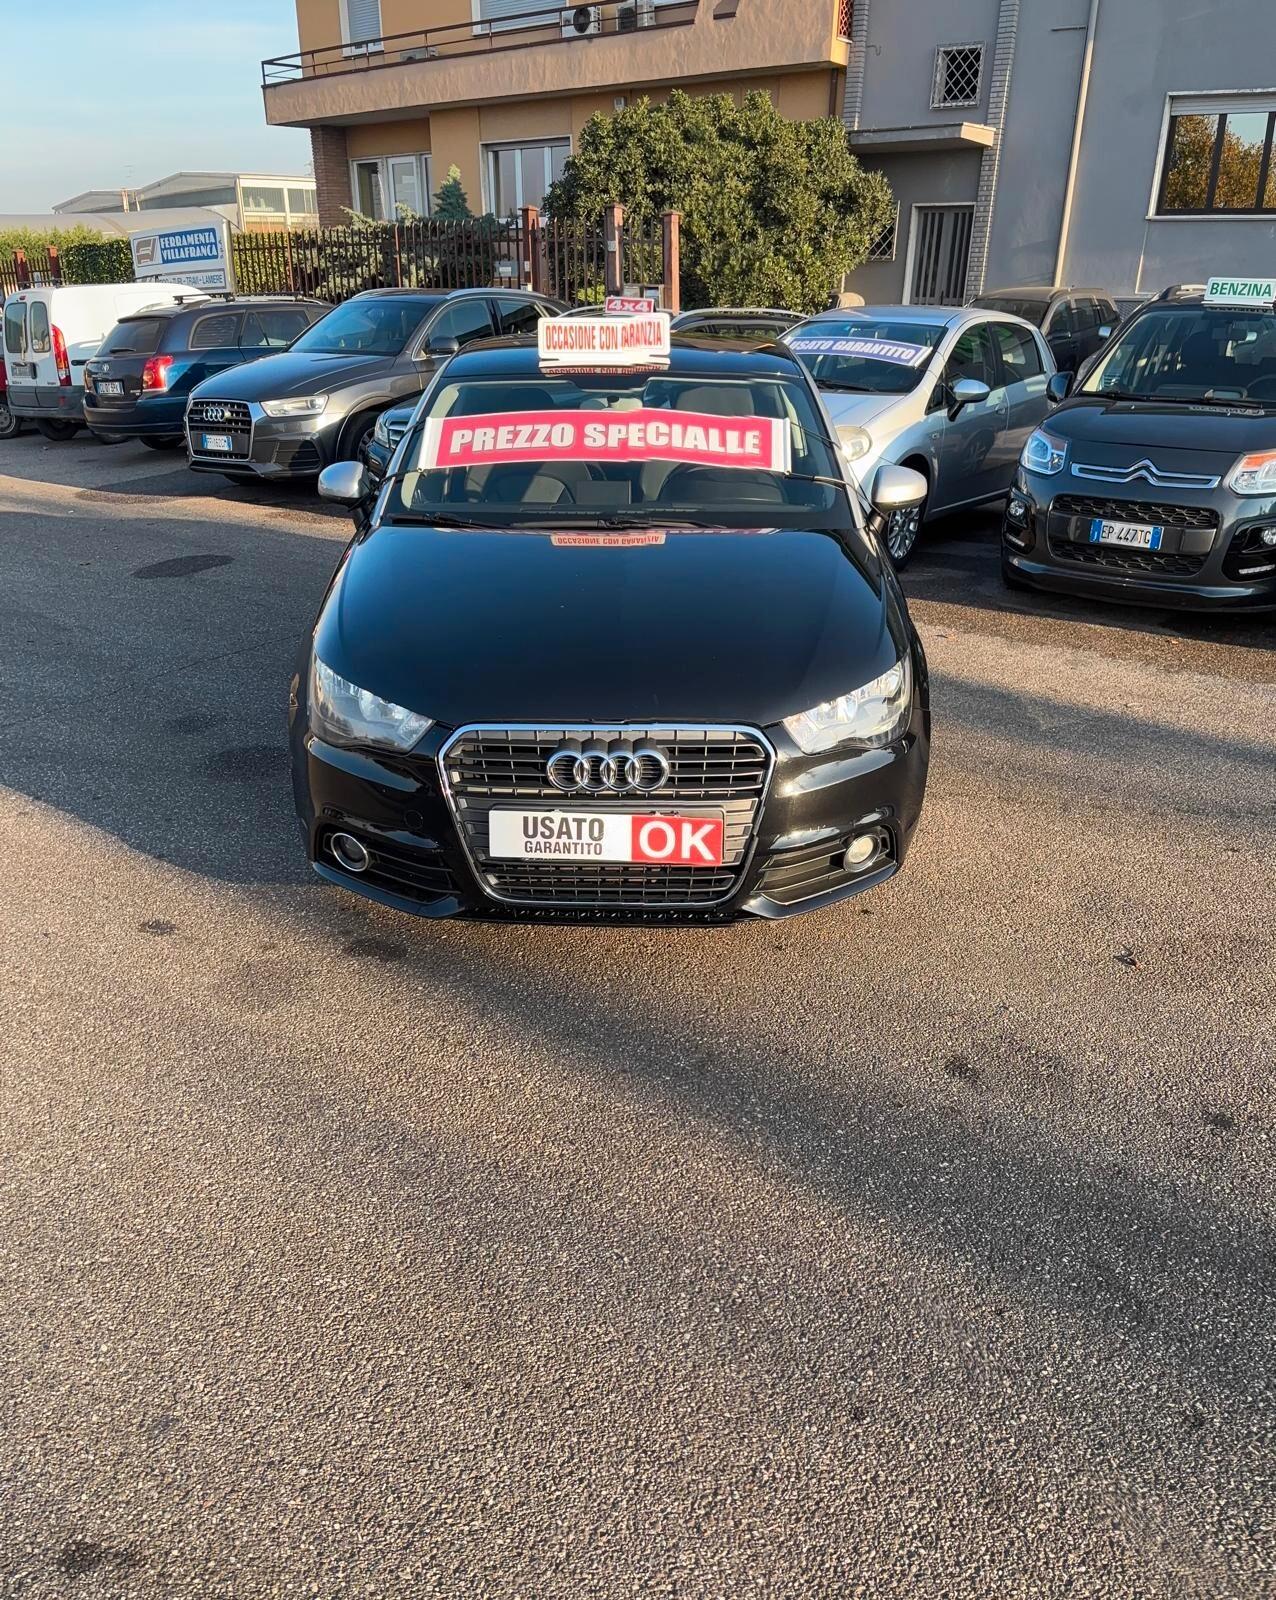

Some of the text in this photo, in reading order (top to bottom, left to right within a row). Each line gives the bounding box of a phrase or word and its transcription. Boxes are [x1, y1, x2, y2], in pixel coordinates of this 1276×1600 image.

[160, 232, 216, 248] FERRAMENTA
[162, 244, 218, 260] VILLAFRANCA
[1209, 282, 1272, 297] BENZINA
[608, 300, 650, 312] 4x4
[545, 324, 596, 351] OCCASIONE
[600, 325, 618, 351] CON
[790, 340, 916, 360] USATO GARANTITO
[449, 423, 574, 454] PREZZO
[1101, 525, 1114, 539] EP
[522, 815, 605, 842] USATO
[524, 840, 603, 856] GARANTITO
[639, 820, 716, 862] OK
